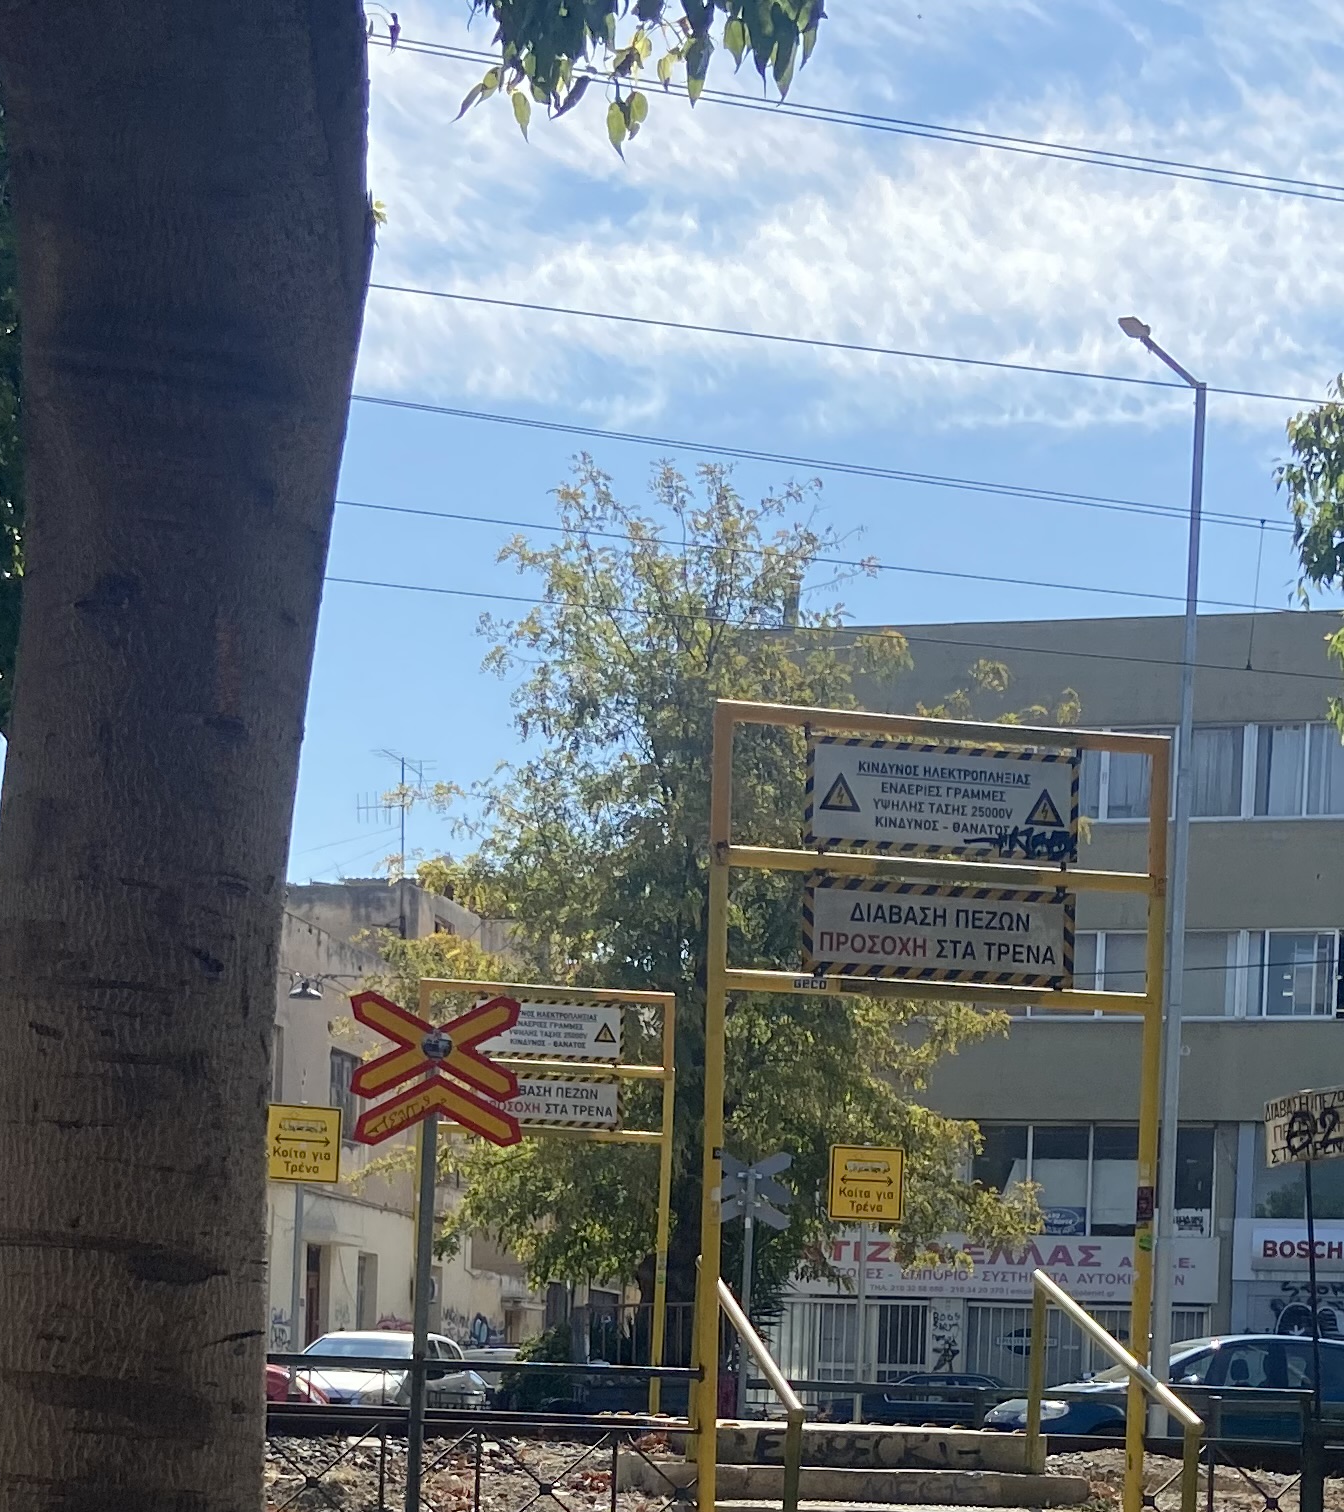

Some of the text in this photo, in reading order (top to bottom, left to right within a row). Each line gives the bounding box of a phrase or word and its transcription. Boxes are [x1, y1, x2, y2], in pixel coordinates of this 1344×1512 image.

[858, 761, 1031, 785] ΚΙΝΔΥΝΟΣ ΗΛΕΚΤΡΟΠΛΗΞΙΑΣ
[881, 782, 1006, 802] ΕΝΑΕΡΙΕΣ ΓΡΑΜΜΕΣ
[873, 798, 1014, 819] ΥΨΗΛΗΣ ΤΑΣΗΣ 25000V
[875, 816, 940, 832] ΚΙΝΔΥΝΟΣ
[849, 902, 1030, 932] ΔΙΑΒΑΣΗ ΠΕΖΩΝ
[820, 931, 1056, 965] ΠΡΟΣΟΧΗ ΣΤΑ ΤΡΕΝΑ
[519, 1085, 598, 1100] ΒΑΣΗ ΠΕΖΩΝ
[545, 1104, 568, 1115] ΣΤΑ
[572, 1105, 613, 1118] ΤΡΕΝΑ
[312, 1151, 330, 1162] για
[284, 1161, 319, 1175] Τρένα
[839, 1187, 894, 1201] Κοίτα για
[849, 1200, 883, 1213] Τρένα
[1263, 1241, 1344, 1260] BOSCH
[982, 1271, 1069, 1284] ΣΥΣΤΗΤΑ
